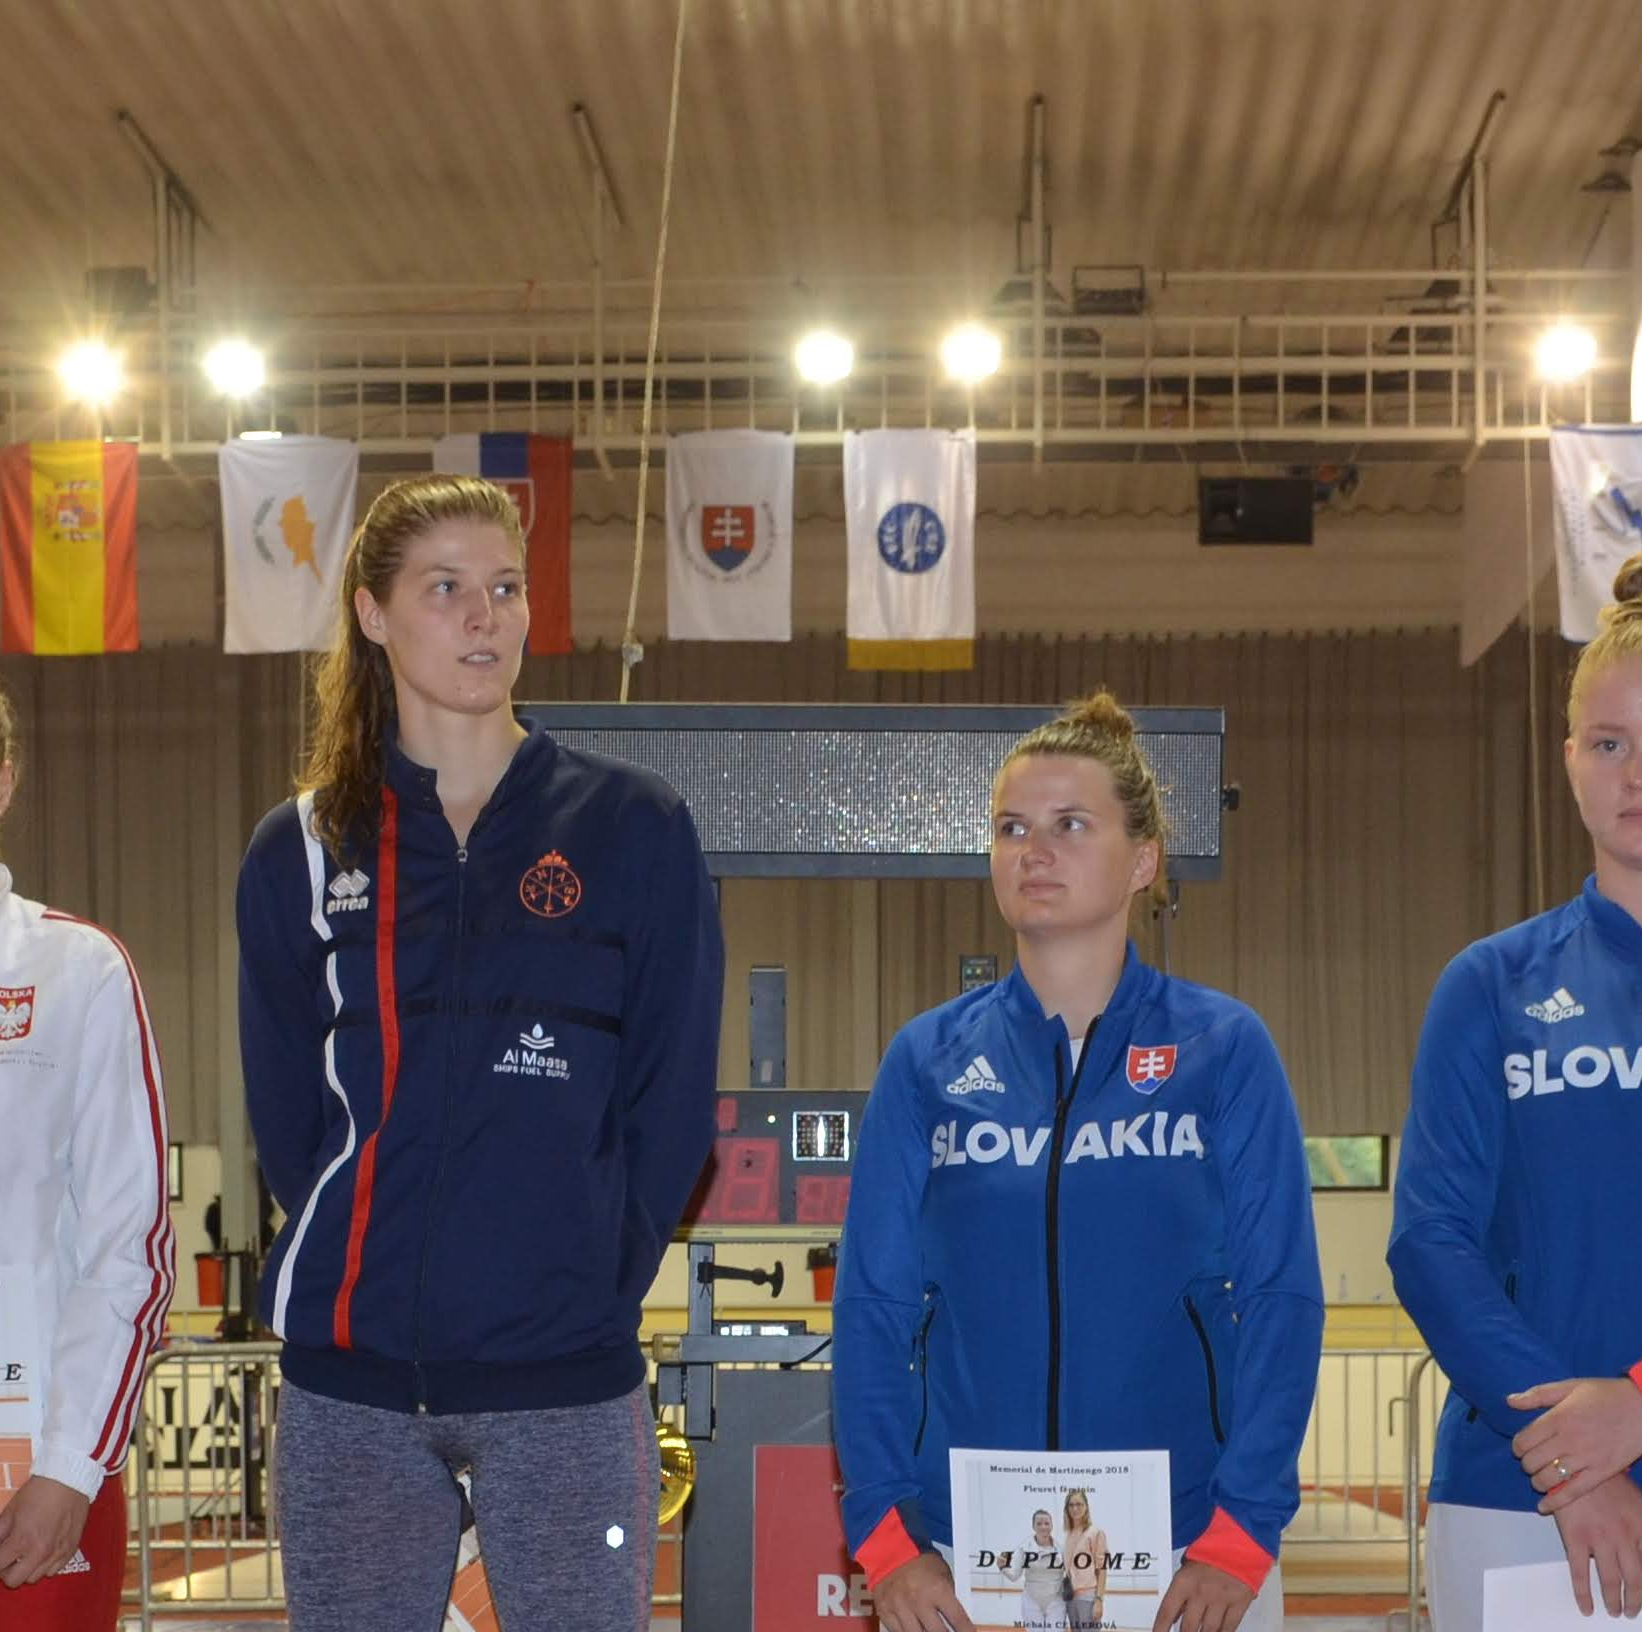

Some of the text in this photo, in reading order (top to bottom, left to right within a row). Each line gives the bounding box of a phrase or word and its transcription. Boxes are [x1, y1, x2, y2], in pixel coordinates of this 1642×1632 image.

[1525, 1002, 1585, 1024] adidas
[503, 1049, 519, 1064] Al
[946, 1073, 1006, 1095] adidas
[931, 1112, 1205, 1168] SLOVAKIA
[990, 1465, 1033, 1475] Memorial
[1035, 1466, 1046, 1475] de
[977, 1549, 1152, 1571] DIPLOME
